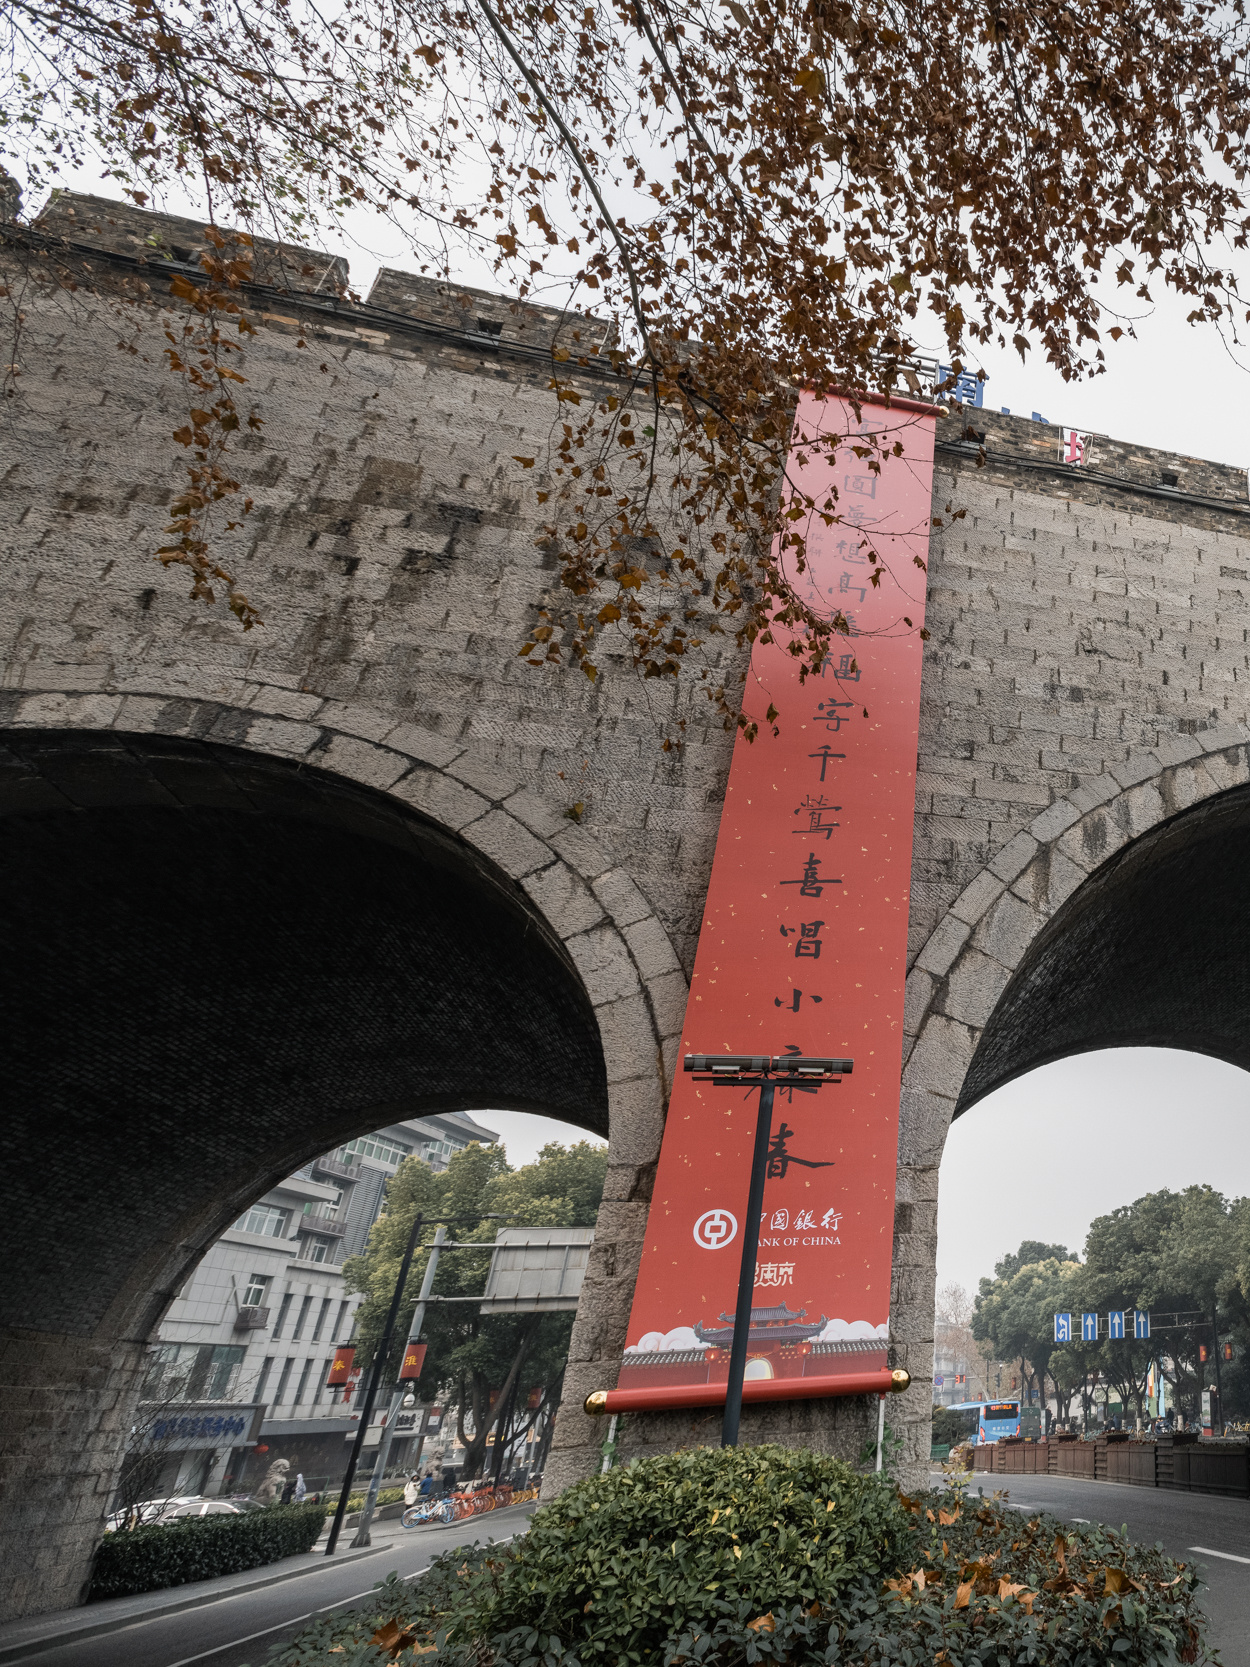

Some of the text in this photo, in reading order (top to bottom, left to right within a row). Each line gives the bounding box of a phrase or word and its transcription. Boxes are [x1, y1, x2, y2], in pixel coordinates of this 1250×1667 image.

[761, 1207, 843, 1231] 國銀行
[757, 1236, 841, 1247] ANK OF CHINA
[753, 1261, 796, 1287] 南京
[955, 1374, 966, 1384] 31
